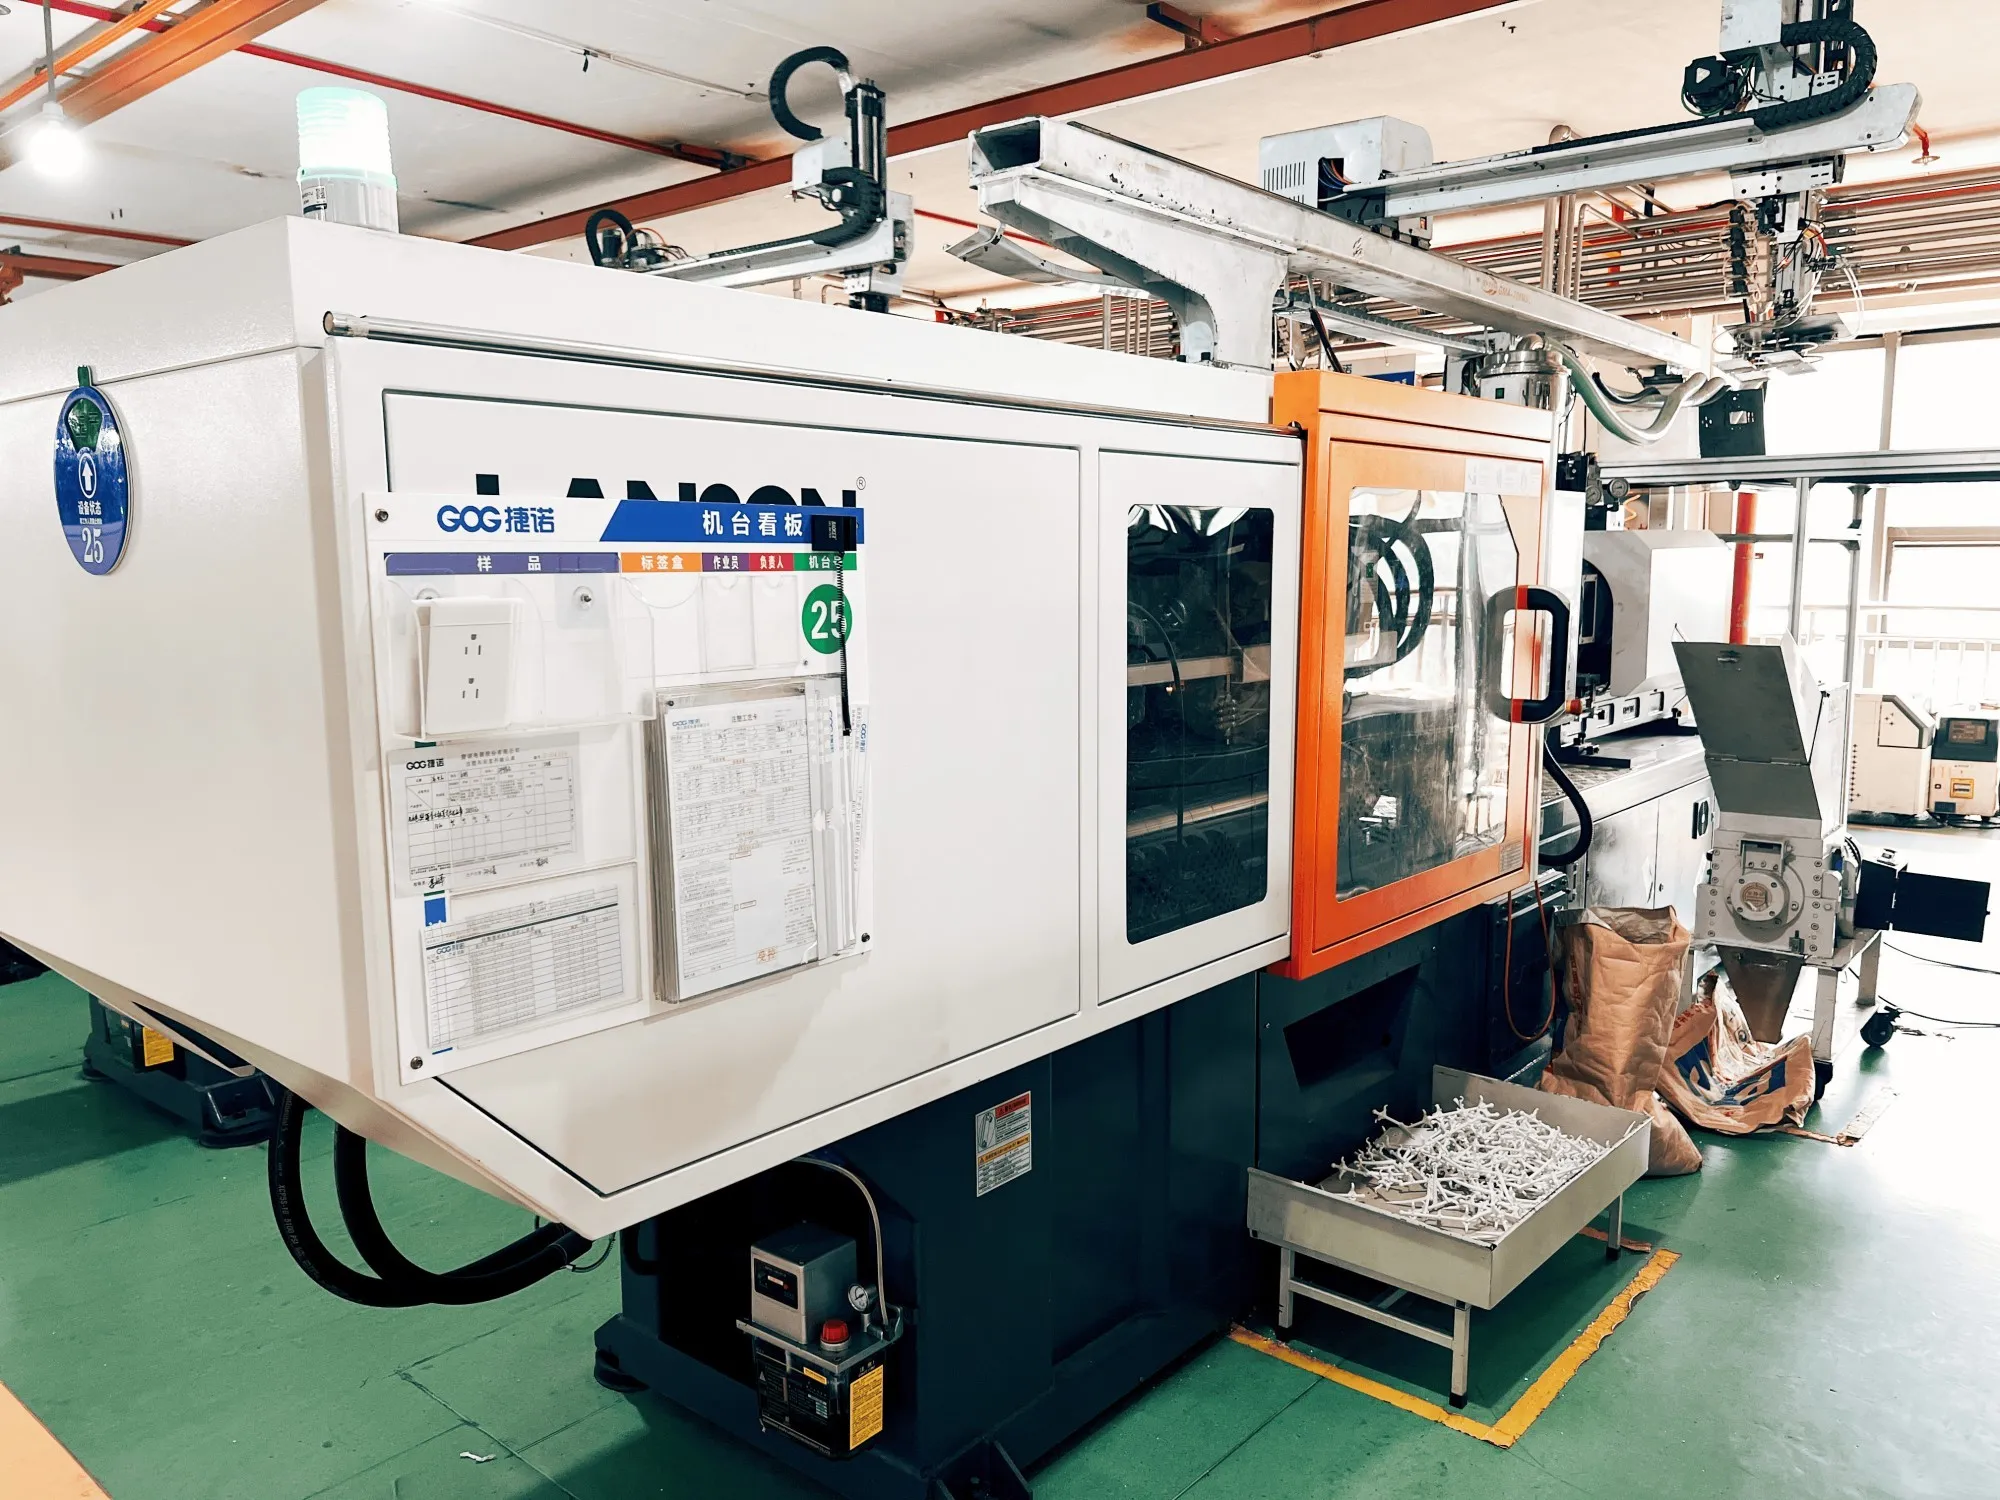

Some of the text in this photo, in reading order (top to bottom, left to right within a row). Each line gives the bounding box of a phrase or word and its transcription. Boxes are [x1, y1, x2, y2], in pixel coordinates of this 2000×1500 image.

[78, 501, 102, 515] 设备状态
[702, 509, 803, 537] 机台看板
[82, 527, 104, 563] 25
[641, 555, 684, 570] 标签盒
[713, 555, 739, 570] 作业员
[760, 555, 784, 569] 负责人
[811, 600, 847, 640] 25
